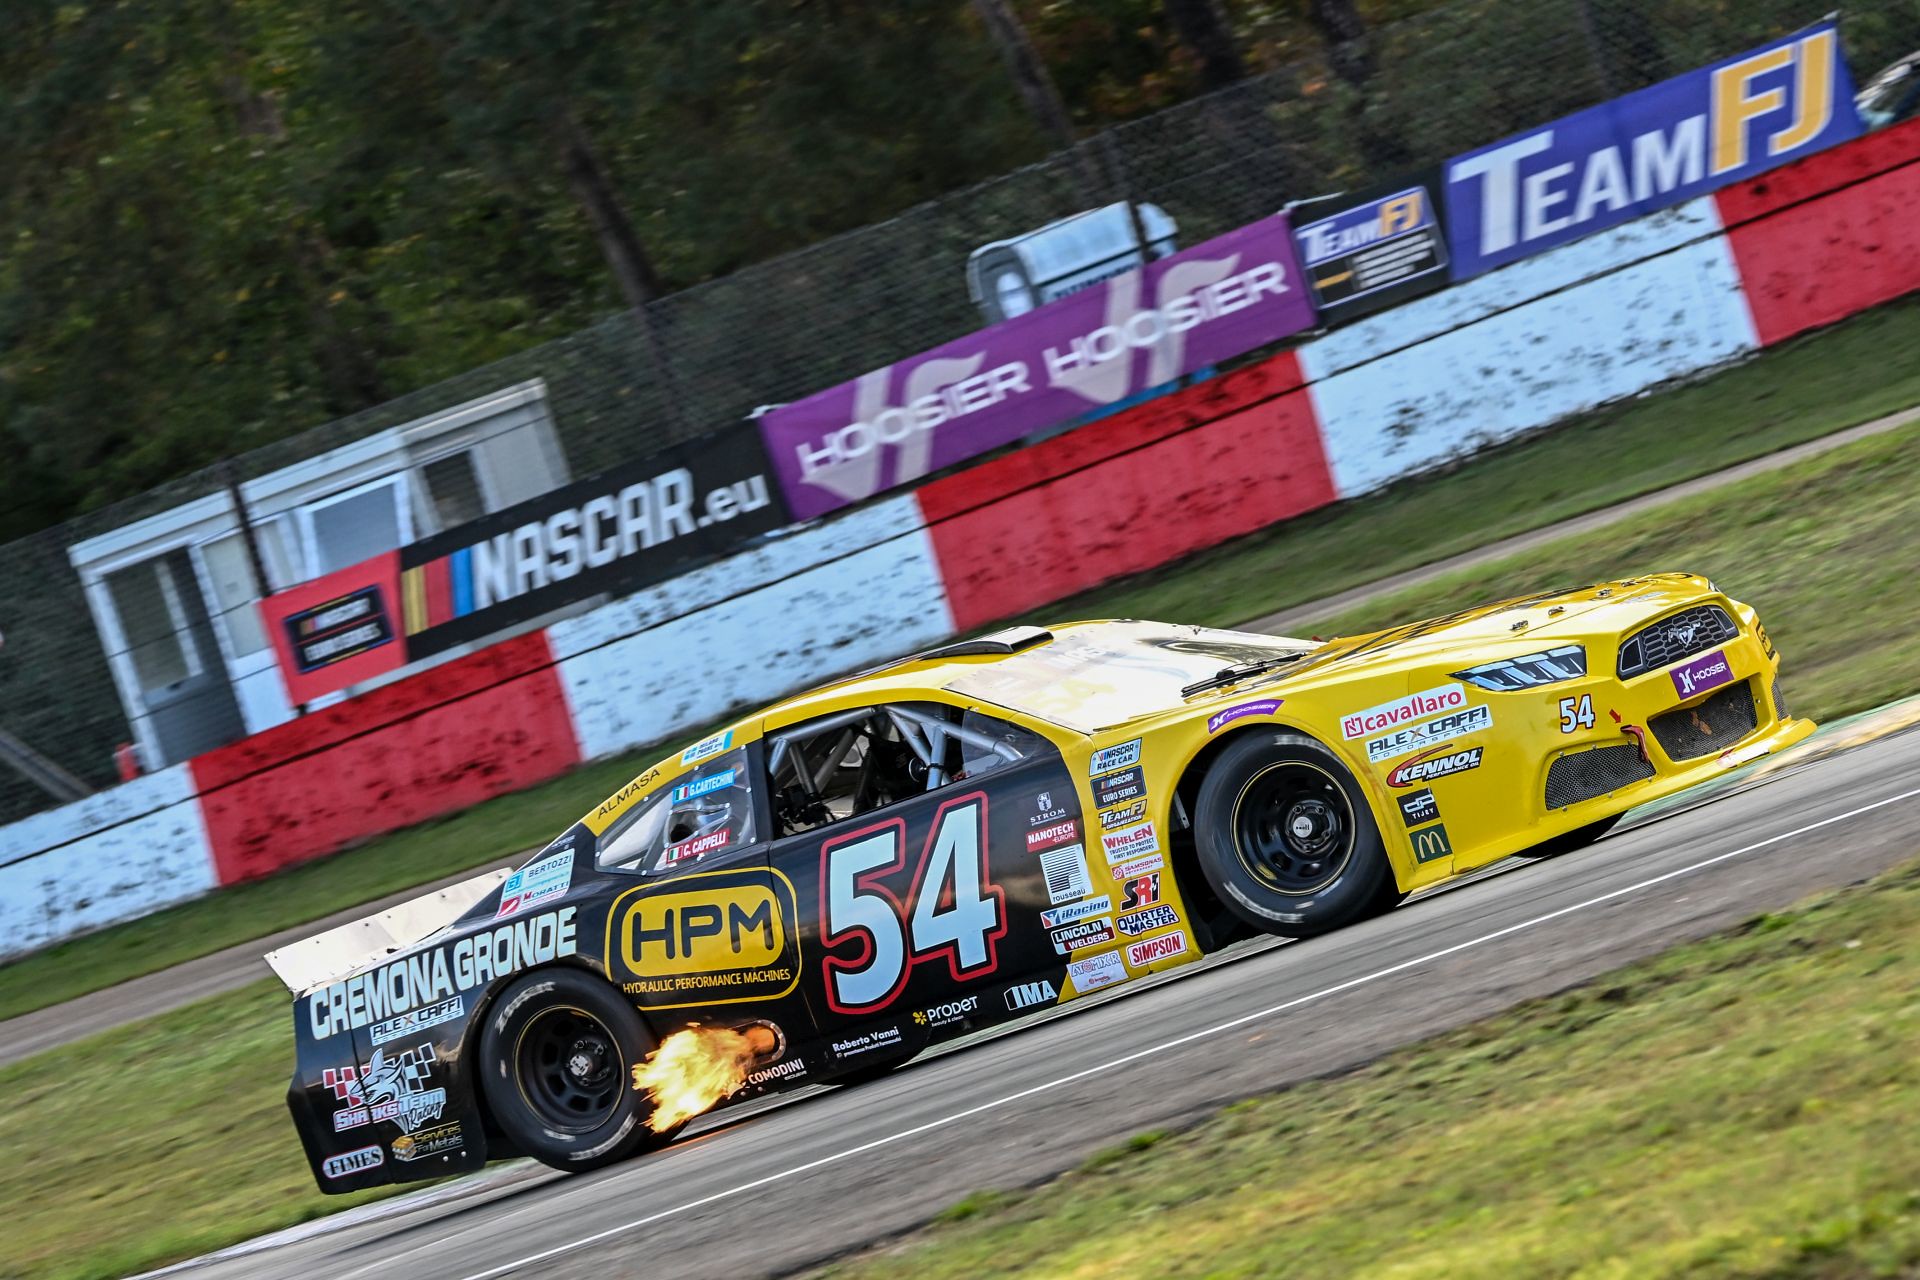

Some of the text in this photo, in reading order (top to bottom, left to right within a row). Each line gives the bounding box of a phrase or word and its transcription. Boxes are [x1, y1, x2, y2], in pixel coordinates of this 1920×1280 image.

[1042, 261, 1291, 379] HOOSIER
[795, 360, 1032, 476] HOOSIER
[471, 467, 770, 611] NASCAR.eu
[1692, 662, 1727, 682] HOOSIER
[1227, 704, 1276, 718] HOOSIER
[1365, 691, 1462, 731] cavallaro
[1559, 693, 1595, 734] 54
[1369, 727, 1427, 754] ALEX
[1428, 706, 1487, 735] CAFFI
[1097, 754, 1133, 770] RACE CAR
[1107, 743, 1134, 759] NASCAR
[1395, 749, 1480, 784] KENNOL
[1426, 764, 1469, 780] PERFORMANCE
[1108, 773, 1133, 787] NASCAR
[598, 768, 660, 819] ALMASA
[1102, 785, 1137, 803] EURO SERIES
[1030, 808, 1066, 823] STROM
[692, 831, 727, 854] CAPPELLI
[1028, 822, 1074, 844] NANOTECH
[1103, 824, 1153, 849] WHELEN
[1110, 845, 1128, 855] TRUSTED
[1136, 837, 1154, 848] PROTECT
[1114, 844, 1154, 860] FIRST RESPONDERS
[528, 855, 572, 877] BERTOZZI
[1125, 856, 1162, 871] SAMSONAS
[524, 881, 569, 901] MORATTI
[824, 796, 1002, 1010] 54
[1053, 889, 1086, 902] rousseau
[1062, 900, 1109, 920] iRacing
[1117, 905, 1170, 931] QUARTER
[632, 899, 775, 963] HPM
[1053, 920, 1102, 943] LINCOLN
[1130, 913, 1176, 935] MASTER
[1069, 931, 1110, 949] WELDERS
[1132, 935, 1181, 963] SIMPSON
[309, 946, 455, 1041] CREMONA
[453, 906, 577, 992] GRONDE
[623, 968, 790, 994] HYDRAULIC PERFORMANCE MACHINES
[1006, 980, 1057, 1010] IMA
[373, 997, 461, 1038] ALEX CAFFI
[832, 1036, 870, 1053] Roberto
[870, 1026, 900, 1042] Vanni
[748, 1058, 804, 1084] COMODINI
[408, 1102, 443, 1131] Racing
[414, 1125, 462, 1142] Services
[329, 1149, 381, 1176] FIMES
